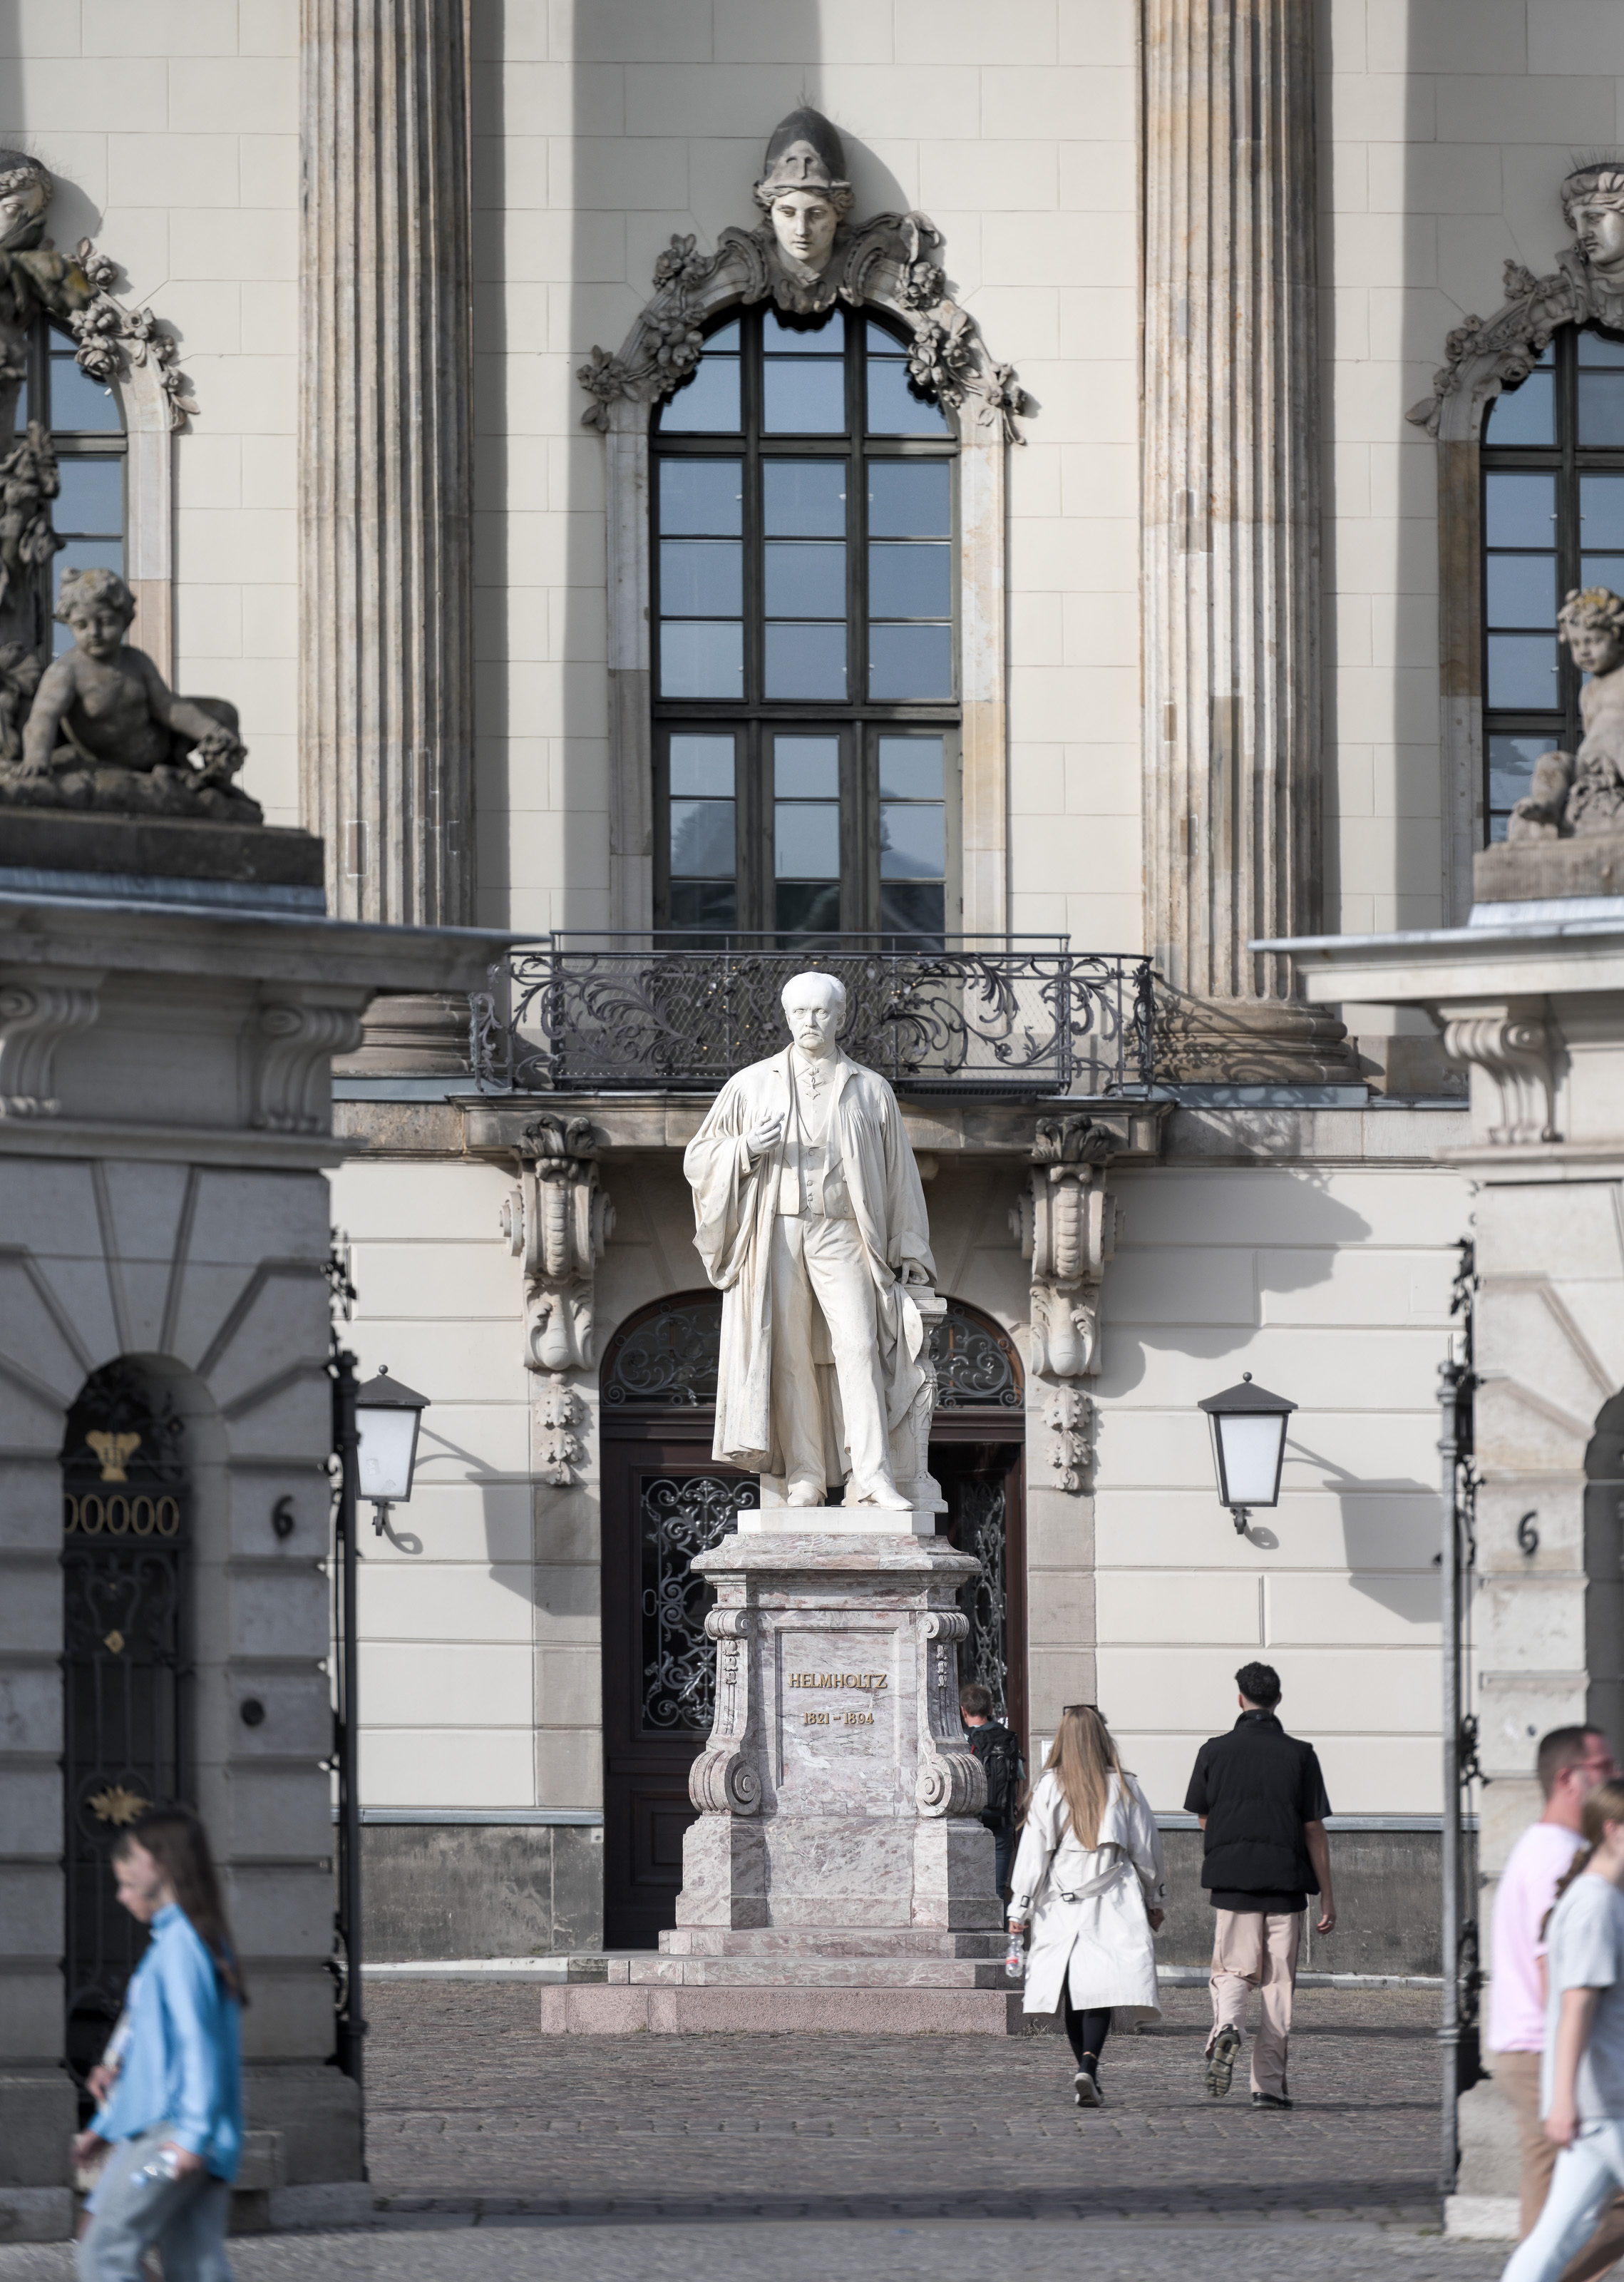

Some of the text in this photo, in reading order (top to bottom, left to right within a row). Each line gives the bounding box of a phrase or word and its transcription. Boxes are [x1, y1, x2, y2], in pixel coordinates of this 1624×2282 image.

[271, 1495, 295, 1540] 6
[1517, 1510, 1539, 1557] 6
[788, 1673, 888, 1688] HELMHOLTZ
[804, 1712, 829, 1724] 1821
[844, 1712, 874, 1724] 1894
